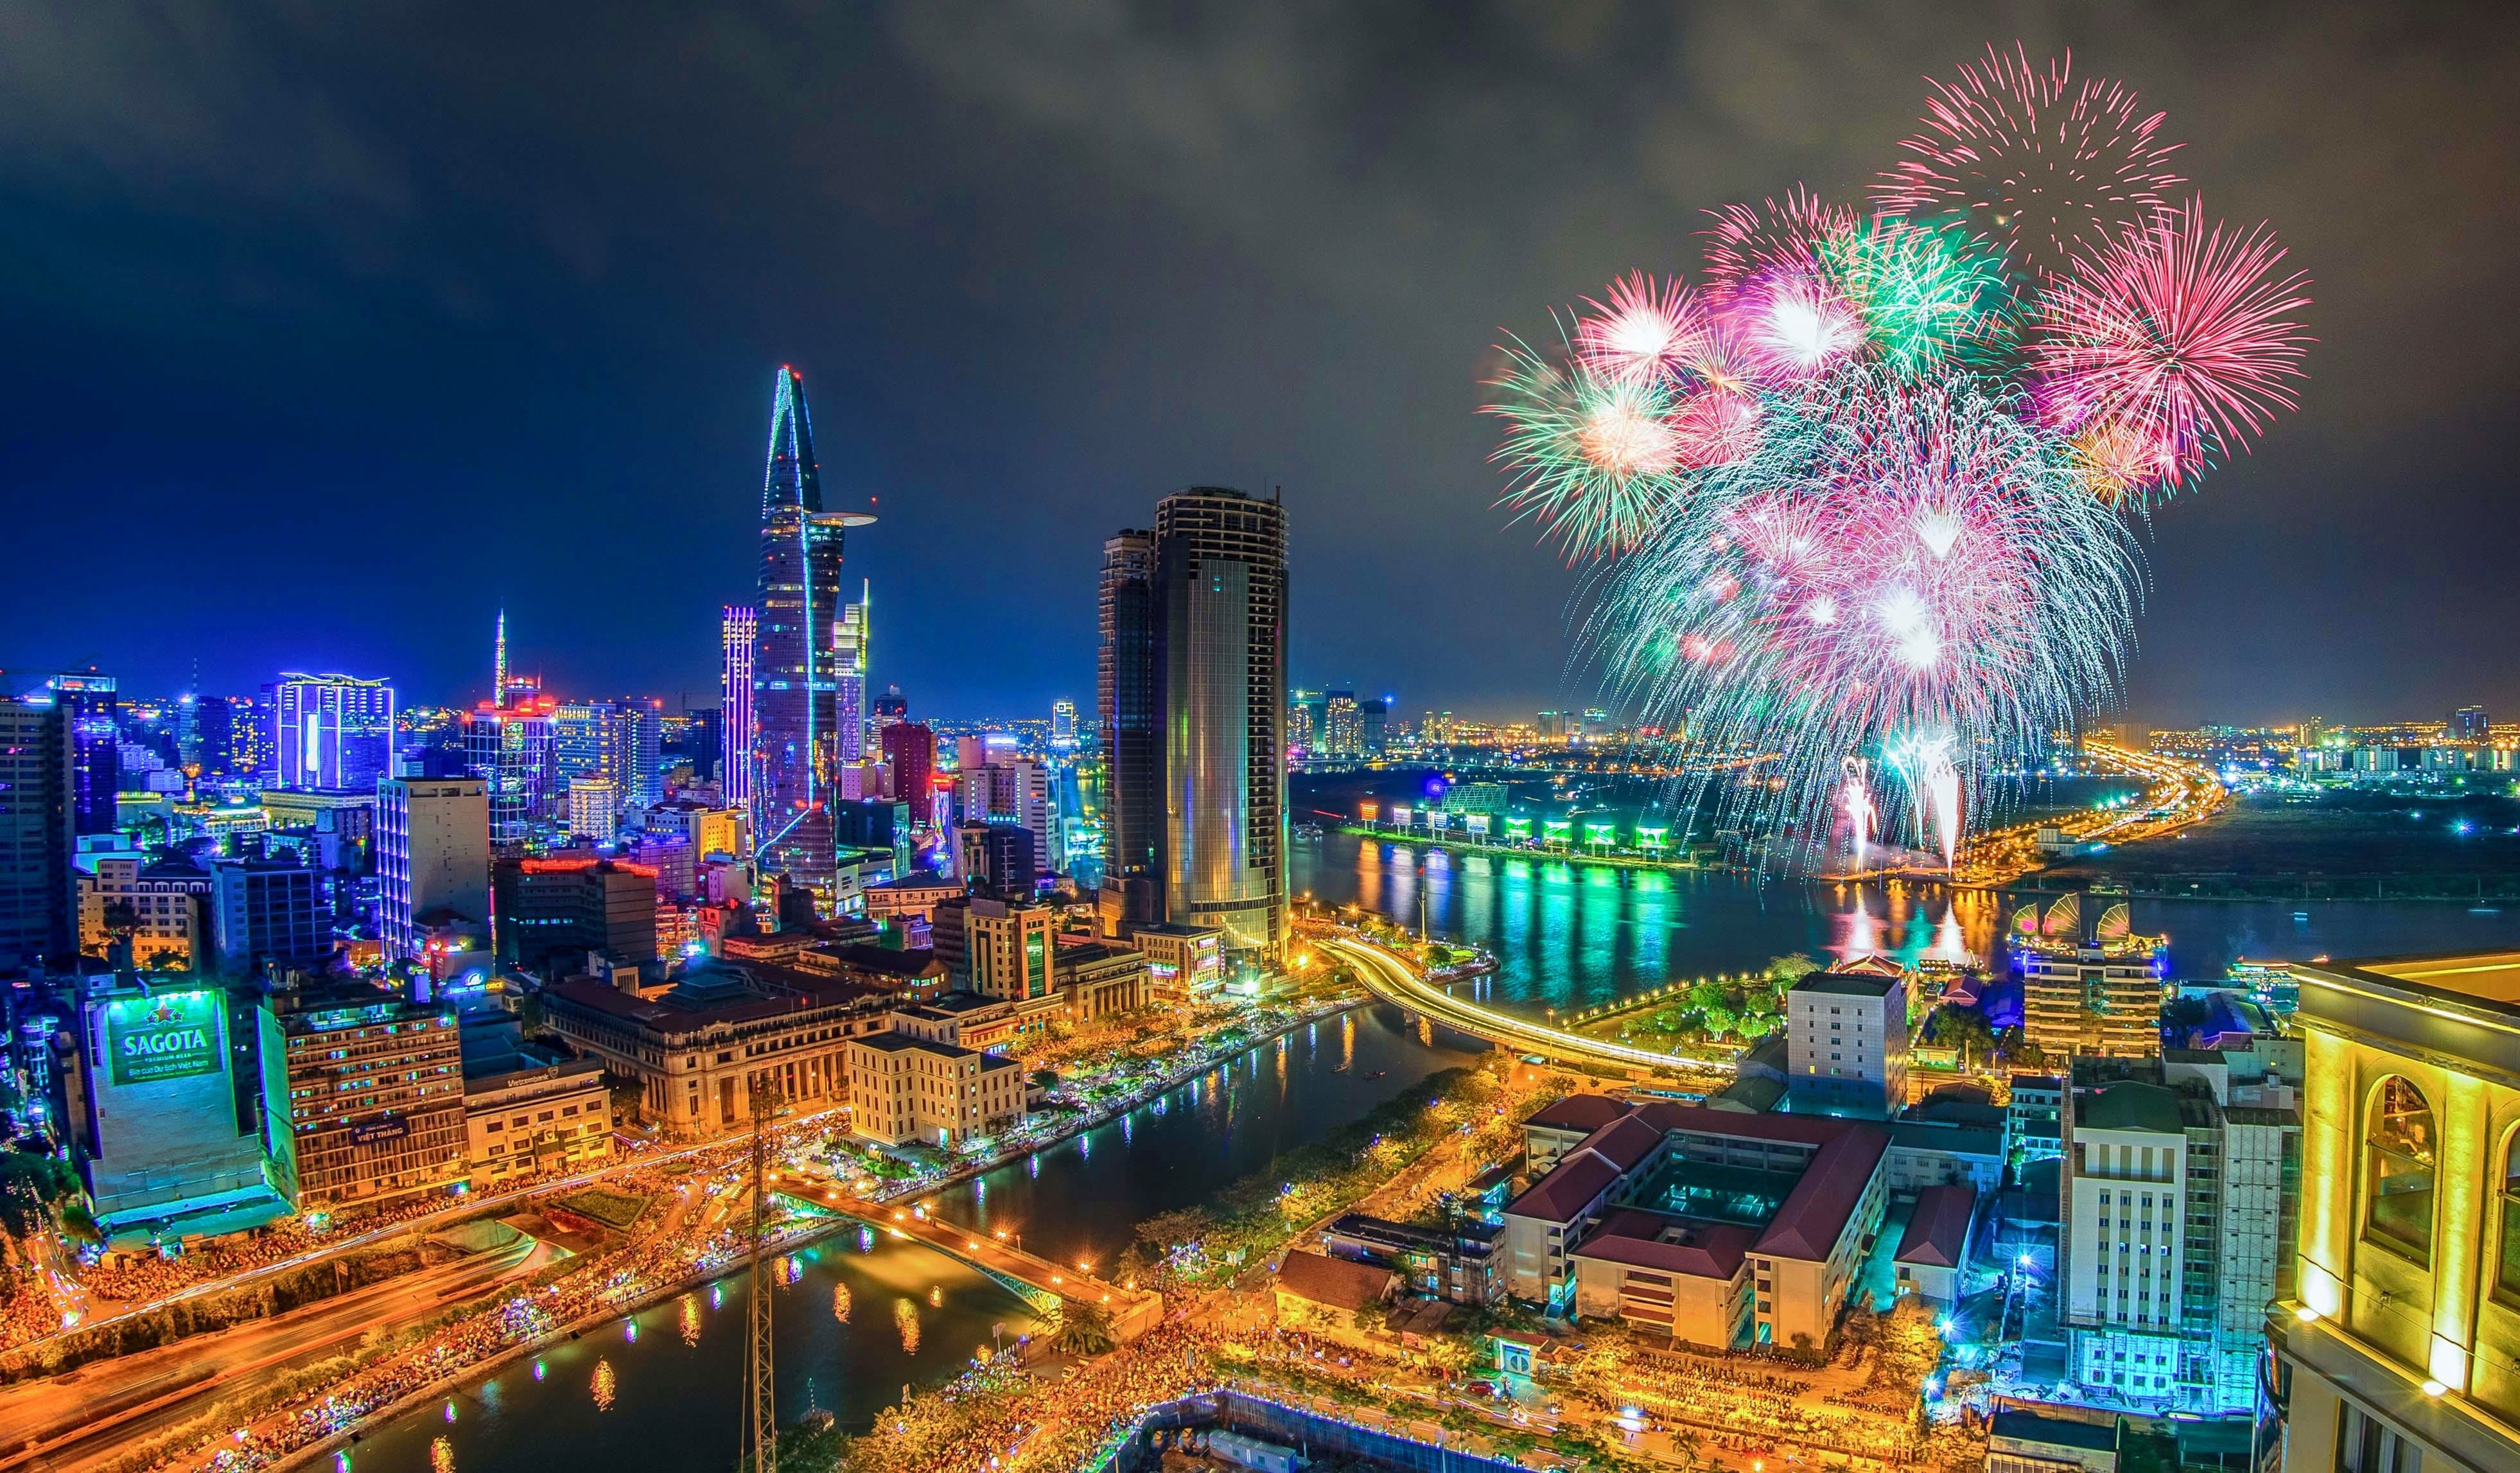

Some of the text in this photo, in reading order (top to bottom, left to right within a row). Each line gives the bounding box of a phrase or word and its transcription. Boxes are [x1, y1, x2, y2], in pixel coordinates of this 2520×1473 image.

[124, 1029, 207, 1056] SAGOTA
[508, 1073, 549, 1087] Vietcombank
[357, 1132, 375, 1142] VIỆT
